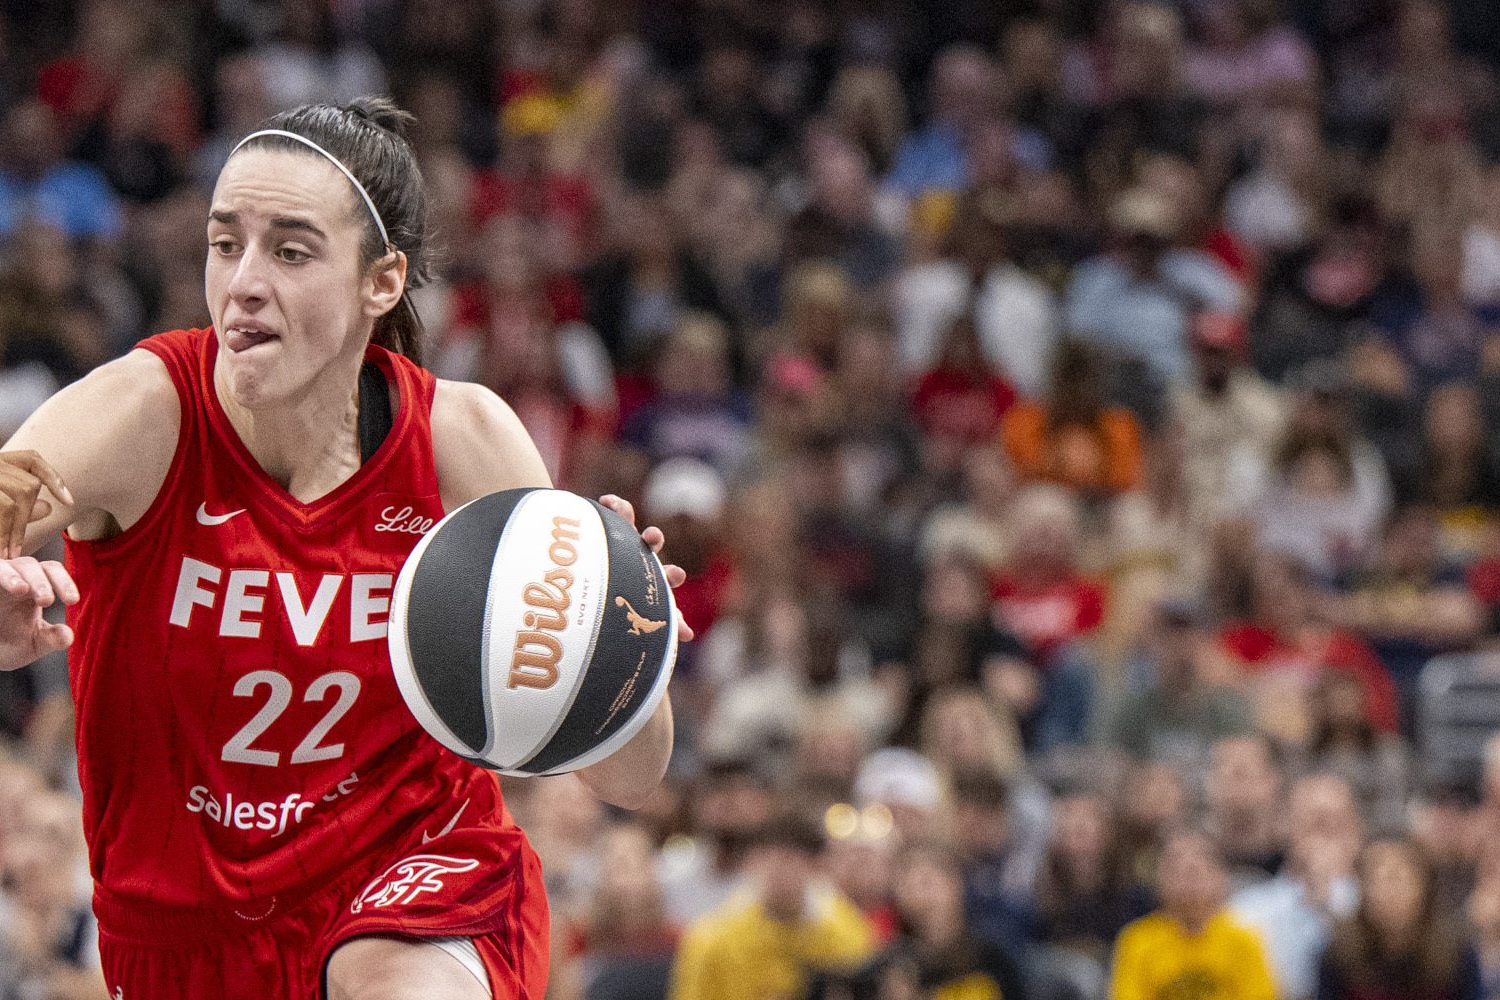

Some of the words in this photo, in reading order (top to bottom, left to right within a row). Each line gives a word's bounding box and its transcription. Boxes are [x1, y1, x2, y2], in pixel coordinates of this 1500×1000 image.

[375, 506, 432, 534] Lill
[168, 556, 394, 648] FEVE
[506, 515, 582, 691] Wilson
[220, 669, 363, 768] 22
